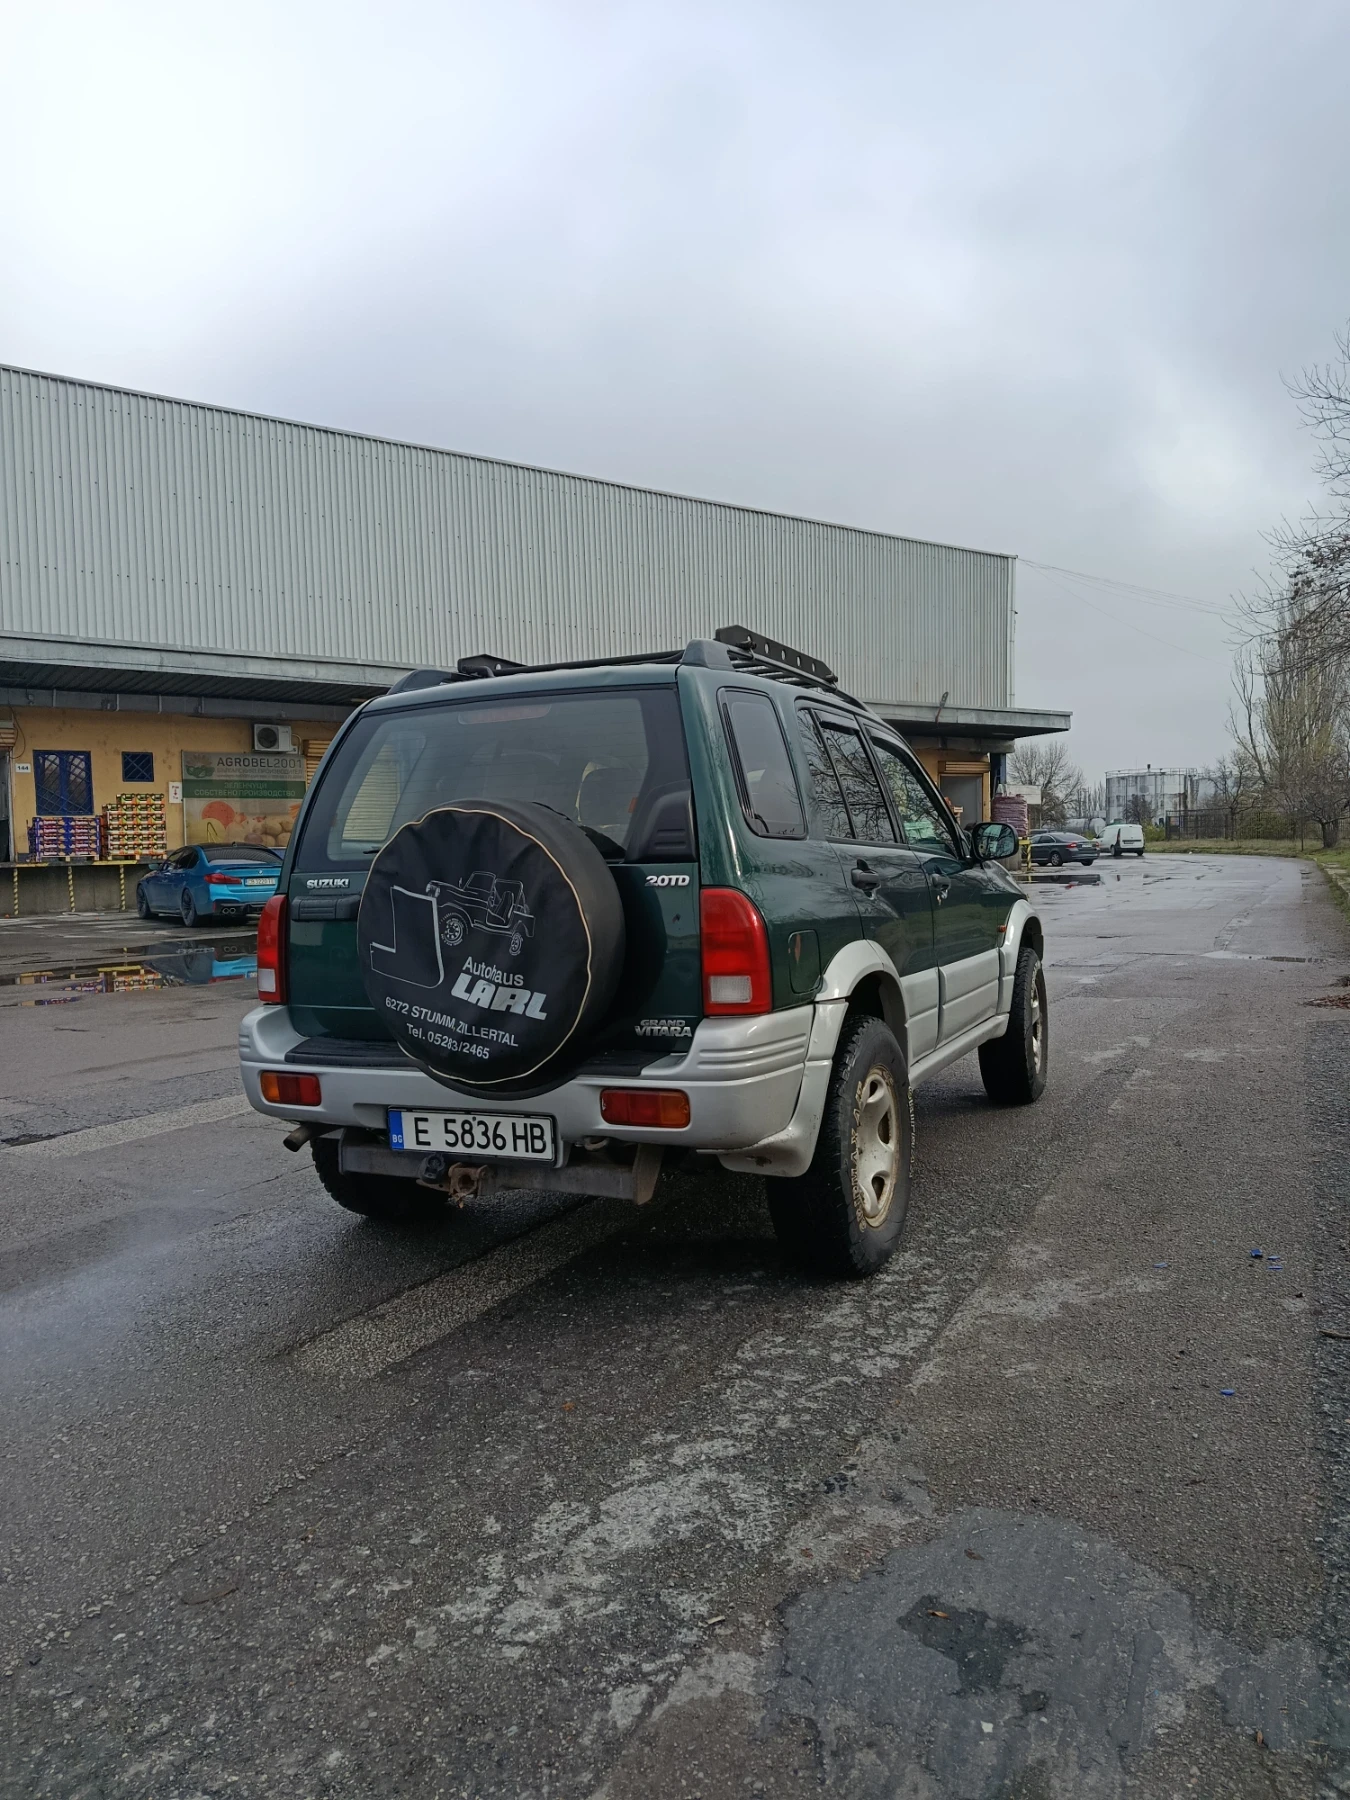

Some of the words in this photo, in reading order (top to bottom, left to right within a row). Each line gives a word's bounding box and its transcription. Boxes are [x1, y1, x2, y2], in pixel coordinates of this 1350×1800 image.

[239, 789, 296, 797] ПРОИЗВОДСТВО
[306, 878, 349, 889] SUZUKI
[462, 956, 525, 986] Autohaus
[385, 996, 409, 1015] 6272
[640, 1018, 686, 1027] GRAND
[634, 1025, 692, 1038] VITARA
[406, 1022, 426, 1041] Tel.
[427, 1031, 490, 1060] 05283/2465
[392, 1134, 403, 1143] BG
[413, 1116, 432, 1147] E
[443, 1118, 507, 1151] 5836
[511, 1121, 548, 1154] HB
